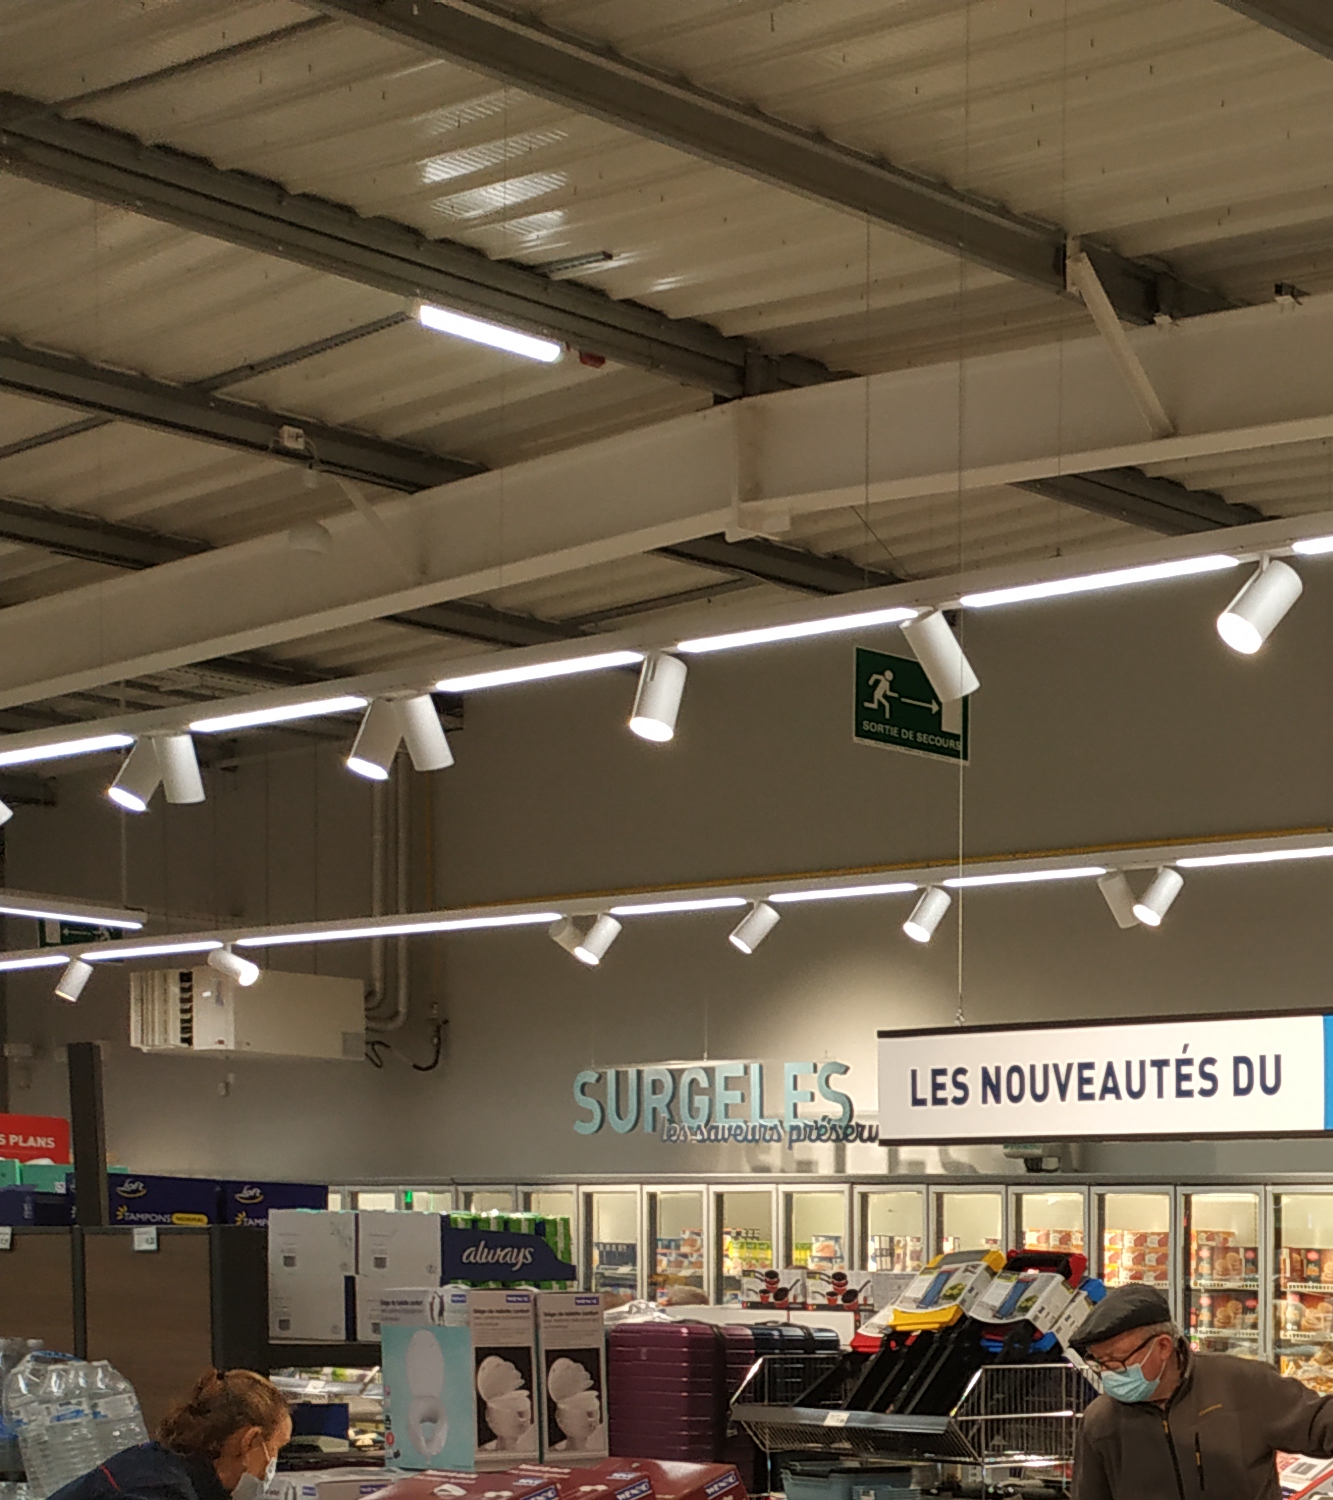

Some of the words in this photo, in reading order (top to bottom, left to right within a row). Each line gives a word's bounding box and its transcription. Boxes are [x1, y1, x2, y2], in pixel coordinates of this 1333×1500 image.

[862, 720, 899, 738] SORTIE
[901, 728, 914, 741] DE
[916, 732, 961, 750] SECOURS
[910, 1065, 970, 1107] LES
[981, 1044, 1219, 1104] NOUVEAUTÉS
[1233, 1054, 1283, 1097] DU
[9, 1134, 55, 1148] PLANS
[788, 1114, 879, 1150] préserv
[124, 1211, 171, 1224] TAMPONS
[243, 1215, 268, 1227] TAMP
[462, 1240, 534, 1271] always
